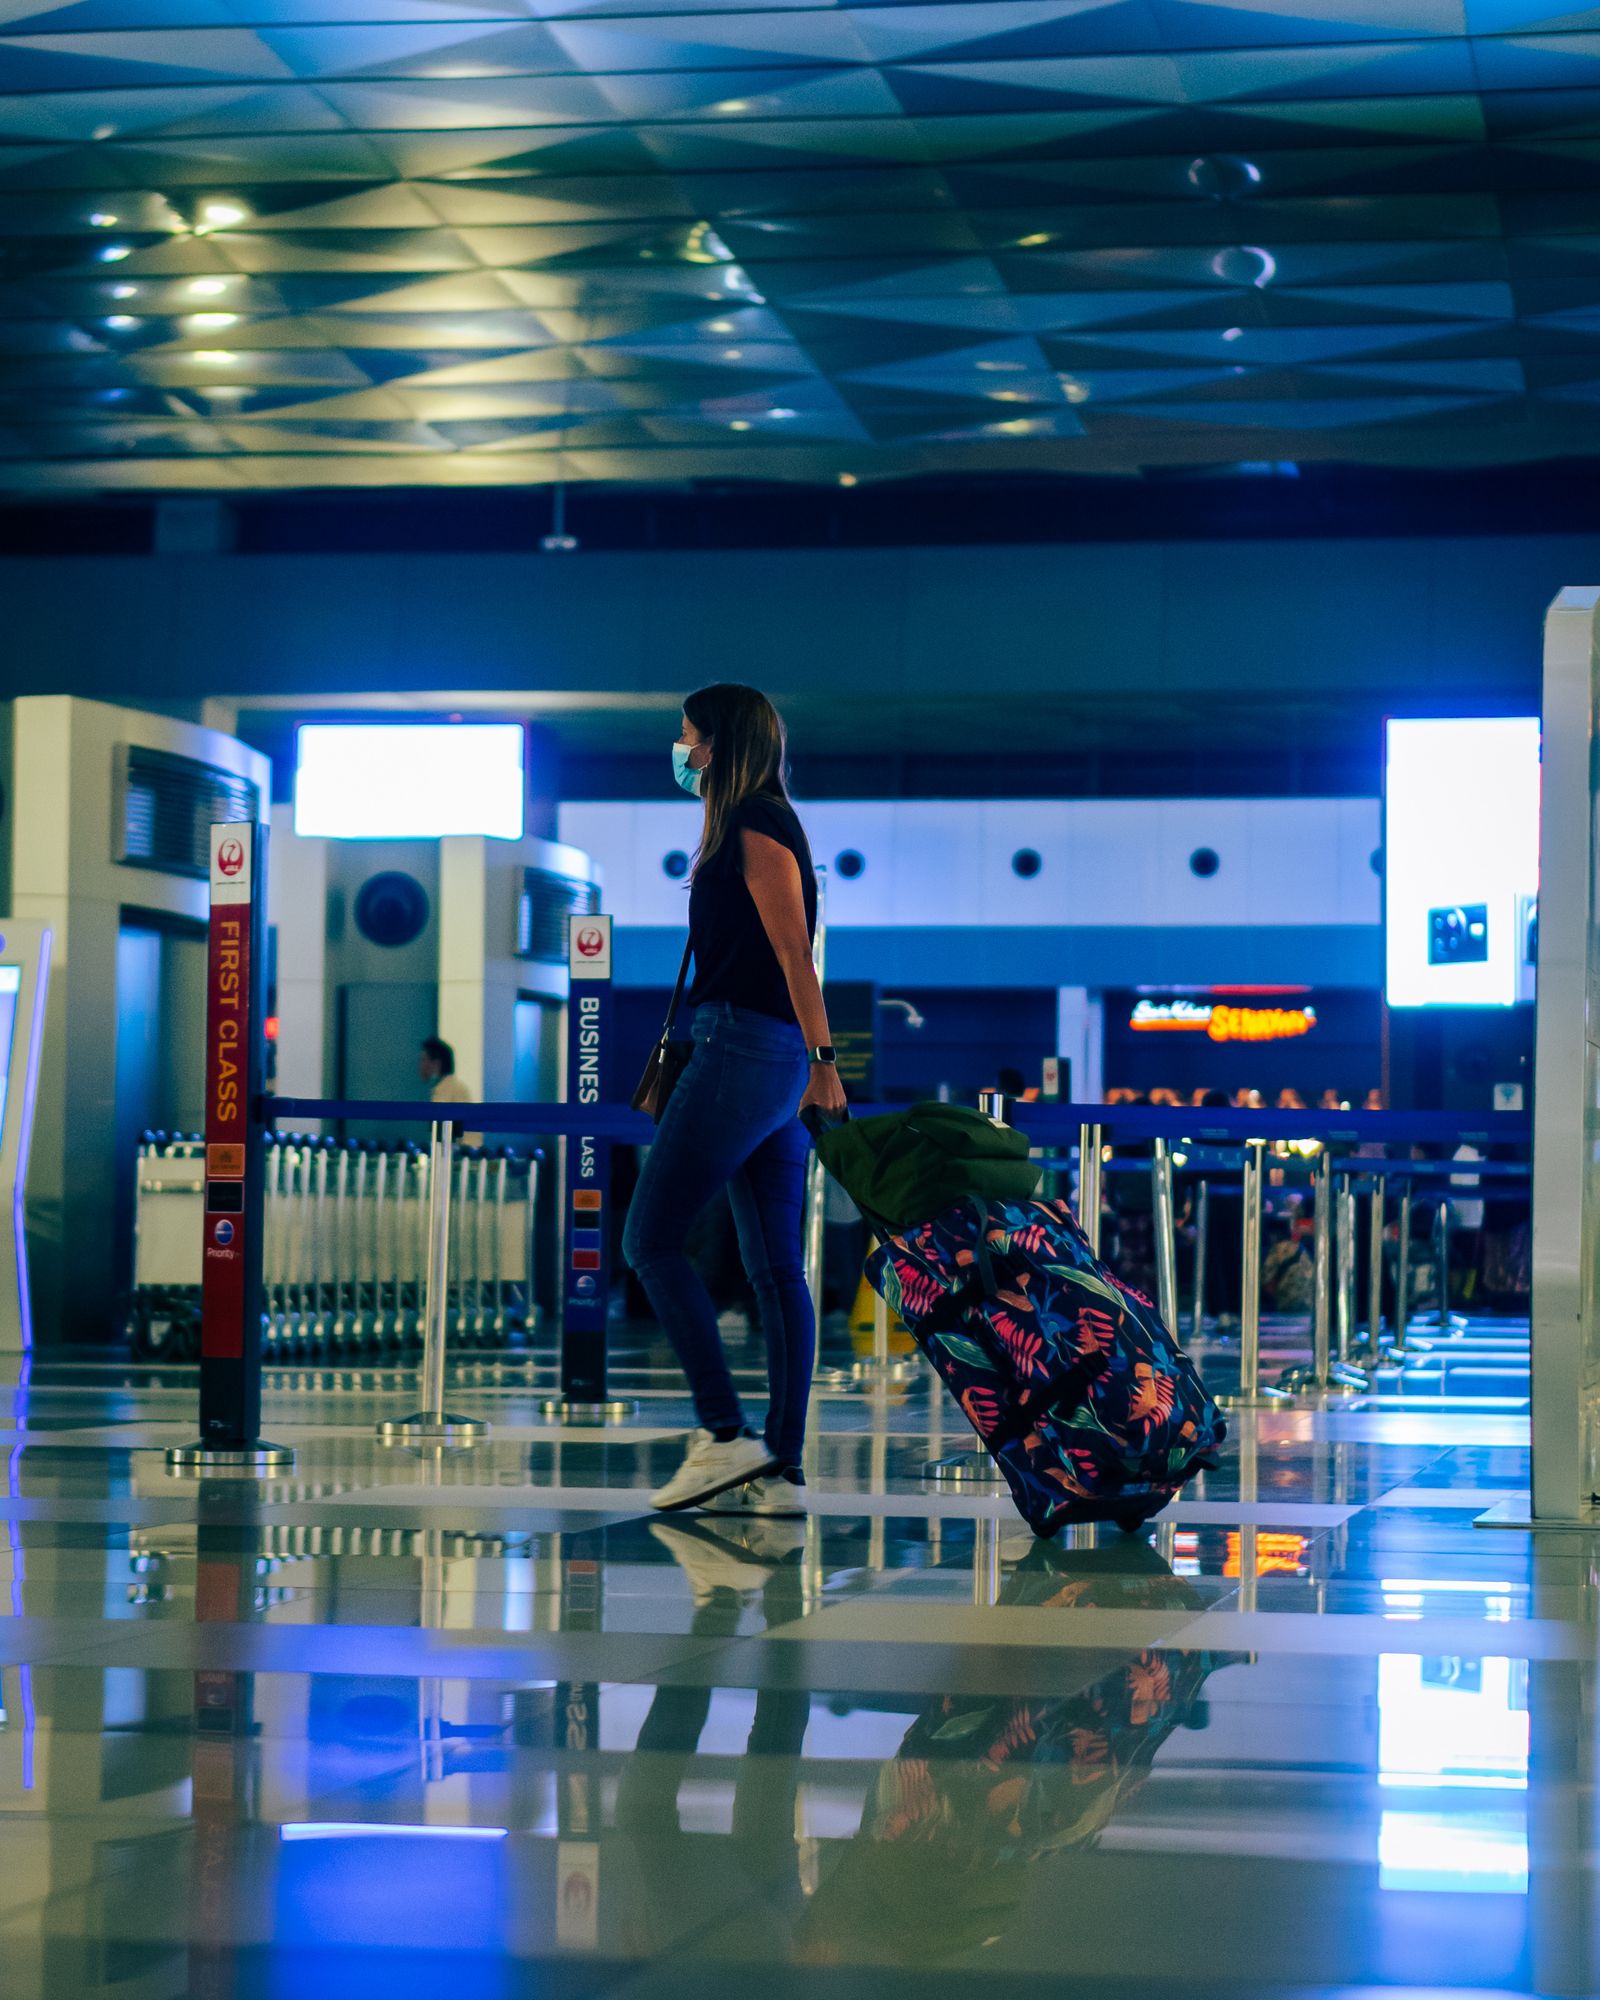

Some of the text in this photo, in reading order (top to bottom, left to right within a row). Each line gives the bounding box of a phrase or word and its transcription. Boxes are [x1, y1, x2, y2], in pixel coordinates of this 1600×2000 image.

[216, 921, 240, 1122] FIRST CLASS
[578, 997, 600, 1178] BUSINES LASS
